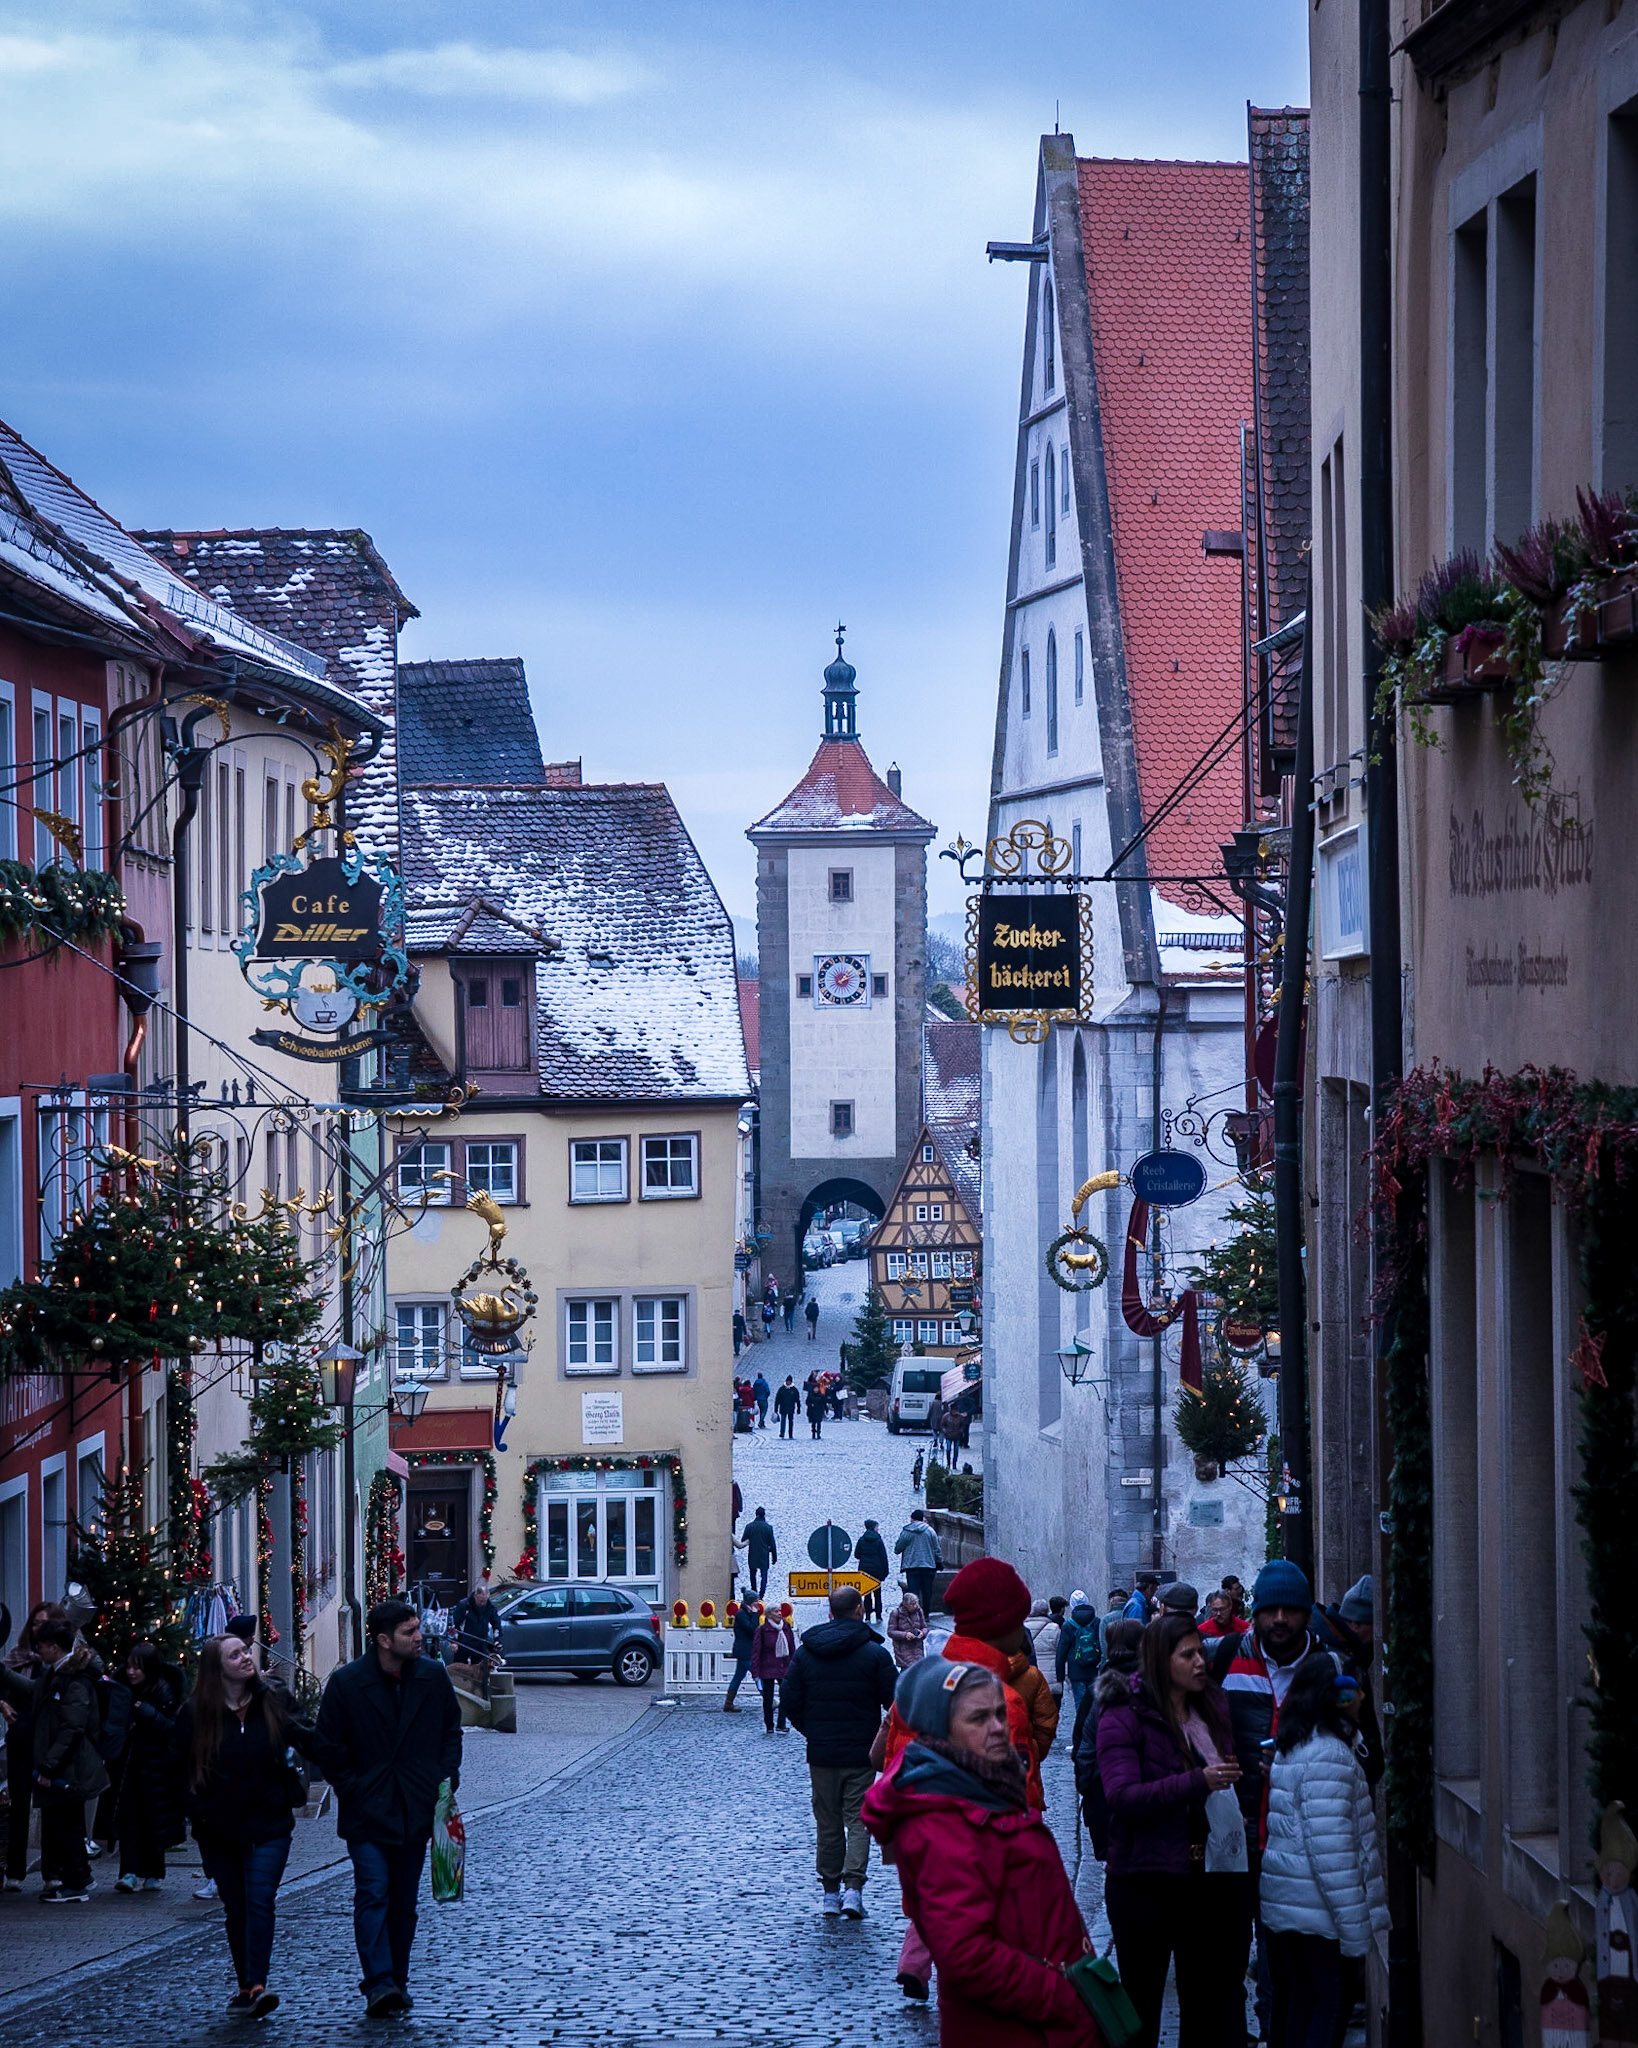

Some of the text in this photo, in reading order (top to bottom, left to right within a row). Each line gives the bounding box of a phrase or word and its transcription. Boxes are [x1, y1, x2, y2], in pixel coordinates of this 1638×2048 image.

[1449, 803, 1470, 896] Die
[1471, 798, 1541, 898] Rustikale
[291, 895, 350, 914] Cafe
[272, 923, 369, 942] Diller
[992, 923, 1067, 950] Zucker-
[989, 961, 1071, 990] bäckerei
[278, 1036, 373, 1058] Schneeballenträume
[1146, 1180, 1196, 1191] Cristallerie
[470, 1338, 512, 1353] Gasthof
[798, 1579, 862, 1591] Umletung
